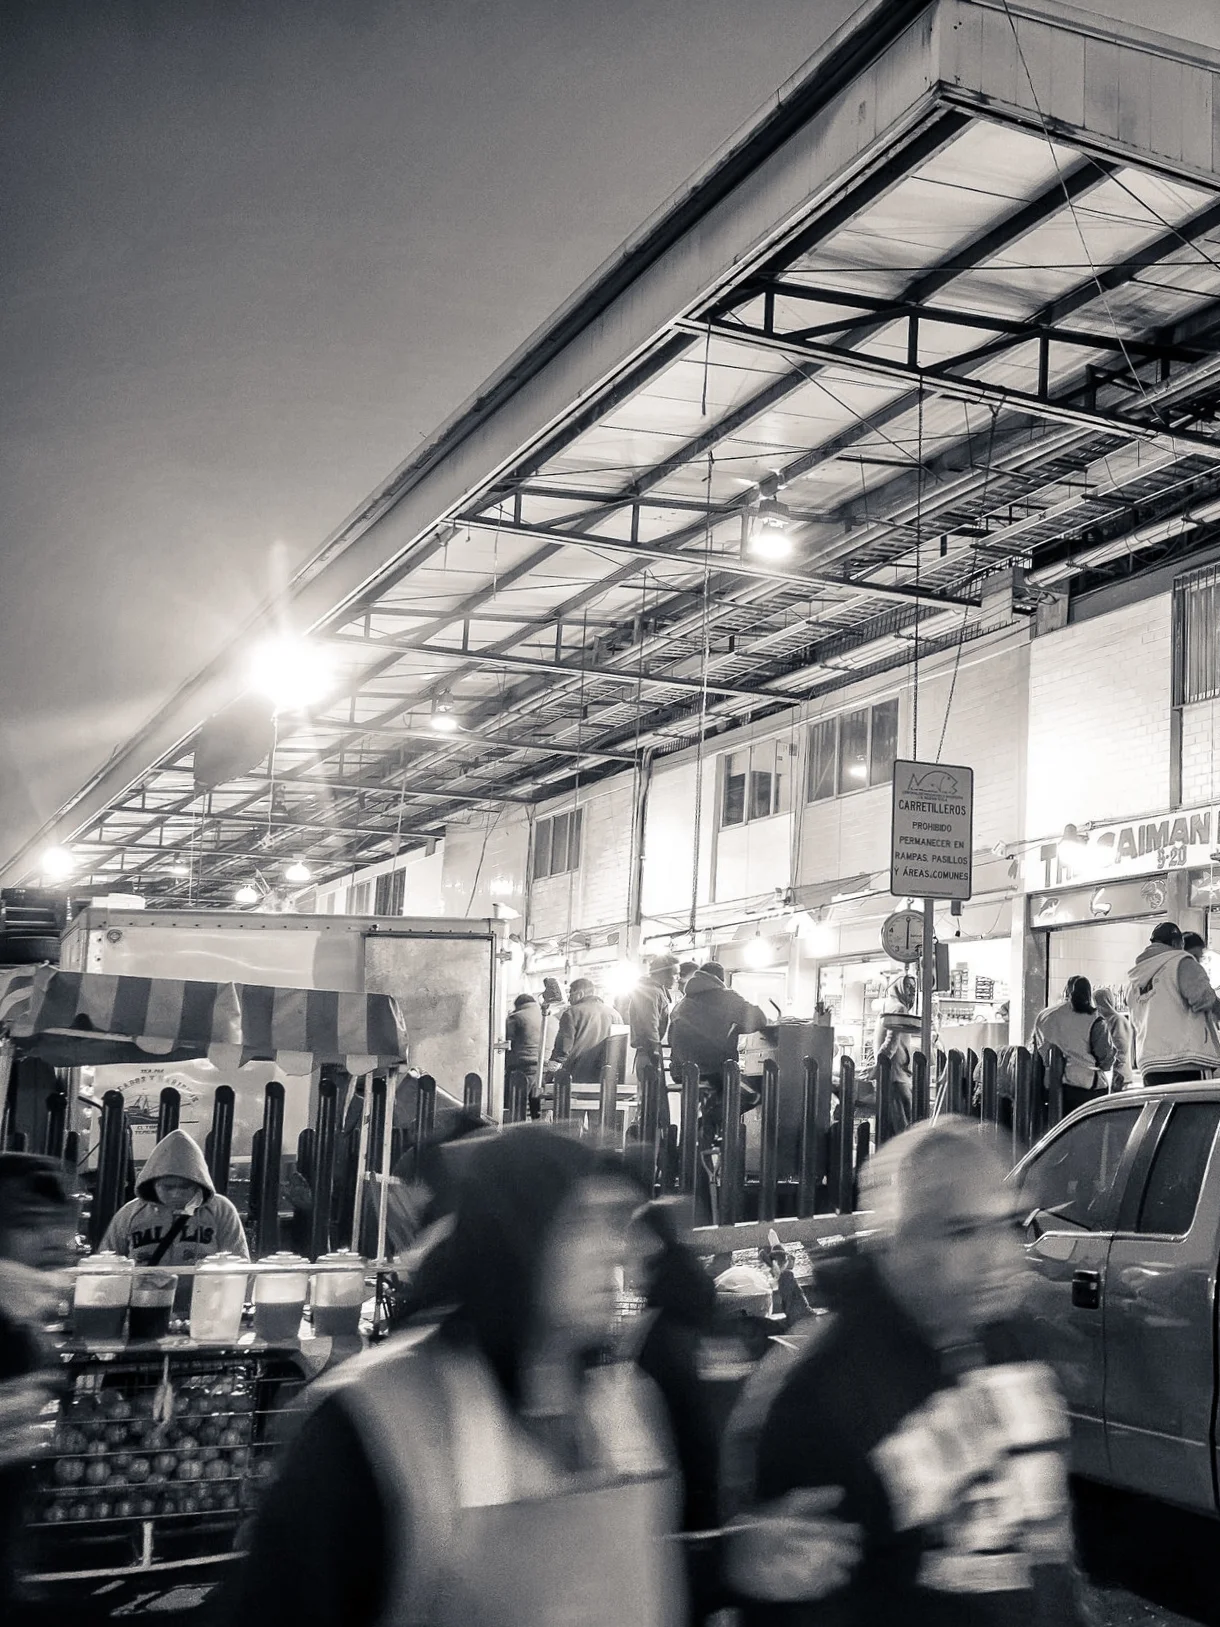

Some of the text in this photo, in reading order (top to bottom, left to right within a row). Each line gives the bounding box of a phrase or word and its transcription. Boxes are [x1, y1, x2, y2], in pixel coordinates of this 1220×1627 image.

[898, 799, 967, 816] CARRETILLEROS
[912, 821, 952, 833] PROHIBIDO
[899, 836, 964, 849] PERMANECER EN
[931, 854, 968, 865] PASILLOS
[894, 867, 899, 876] Y
[932, 869, 969, 881] COMUNES
